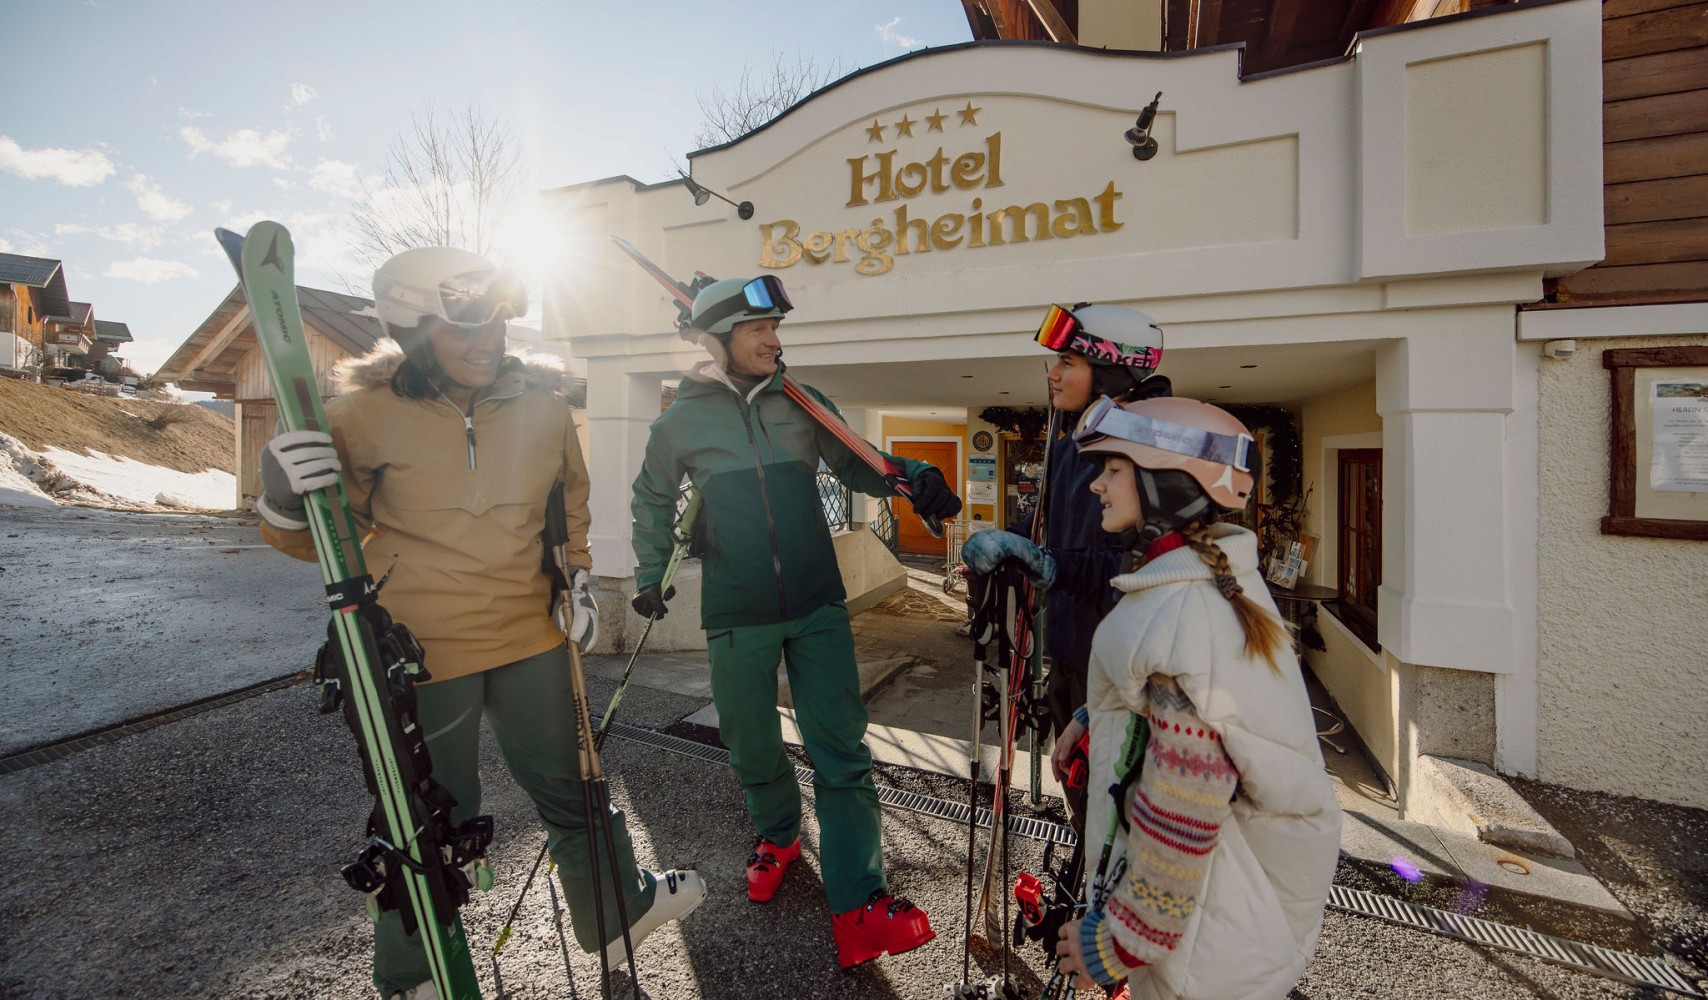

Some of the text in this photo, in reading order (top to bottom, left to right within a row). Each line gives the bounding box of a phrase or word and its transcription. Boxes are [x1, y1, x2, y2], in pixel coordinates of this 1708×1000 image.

[845, 131, 1005, 208] Hotel
[758, 180, 1125, 276] Bergheimat
[270, 289, 291, 344] ATOMIC
